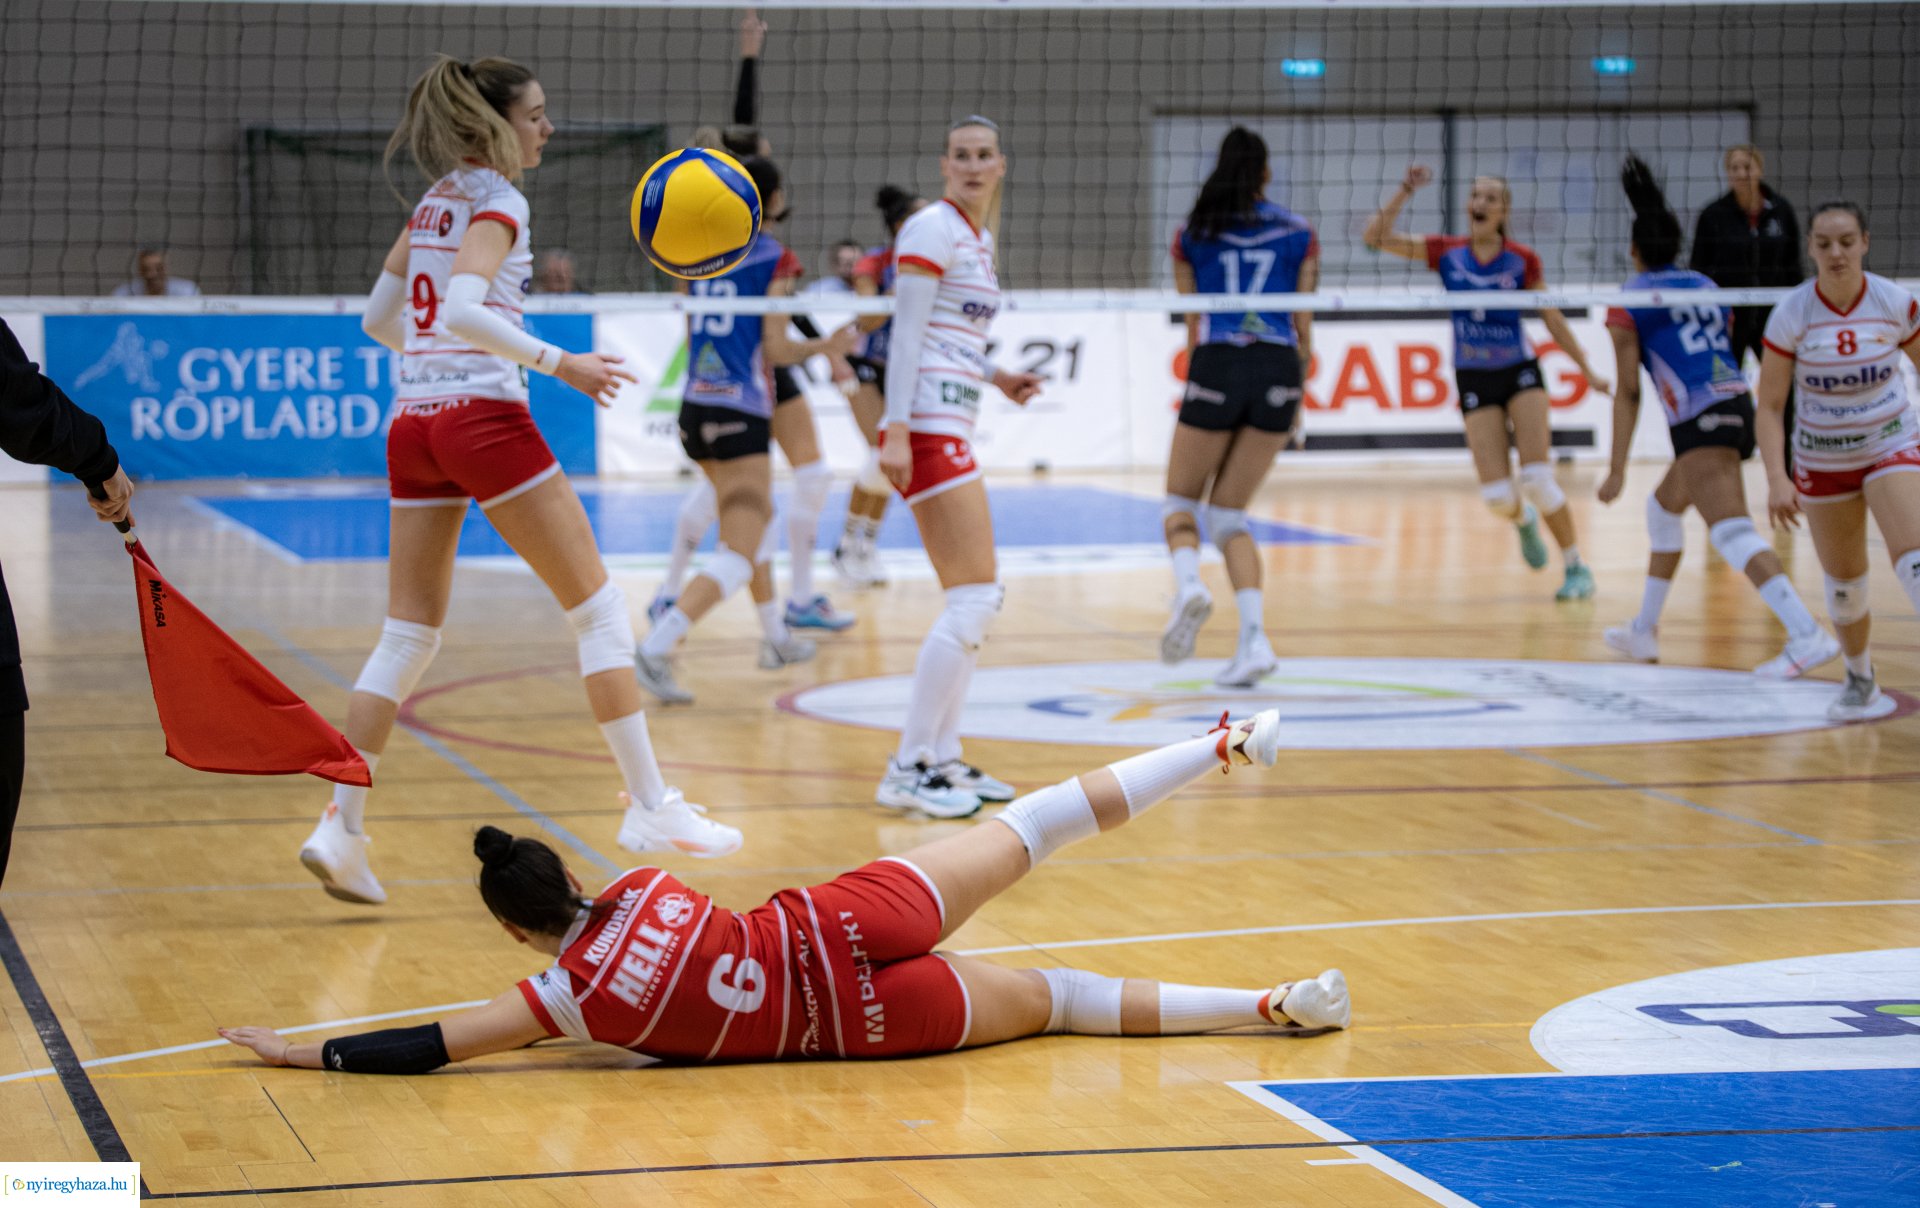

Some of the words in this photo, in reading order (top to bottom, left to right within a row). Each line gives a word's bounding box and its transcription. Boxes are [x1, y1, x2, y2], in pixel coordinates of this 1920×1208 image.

[1219, 249, 1277, 297] 17
[413, 273, 437, 330] 9
[1670, 303, 1730, 355] 22
[1836, 329, 1858, 356] 8
[178, 347, 344, 392] GYERE
[1019, 339, 1082, 382] 21
[1804, 365, 1892, 389] apollo
[148, 579, 167, 628] MIKASA
[582, 887, 644, 966] KUNDRÁK
[606, 921, 674, 1009] HELL
[638, 968, 664, 1012] ENERGY
[661, 934, 681, 968] DRINK
[707, 953, 766, 1023] 6
